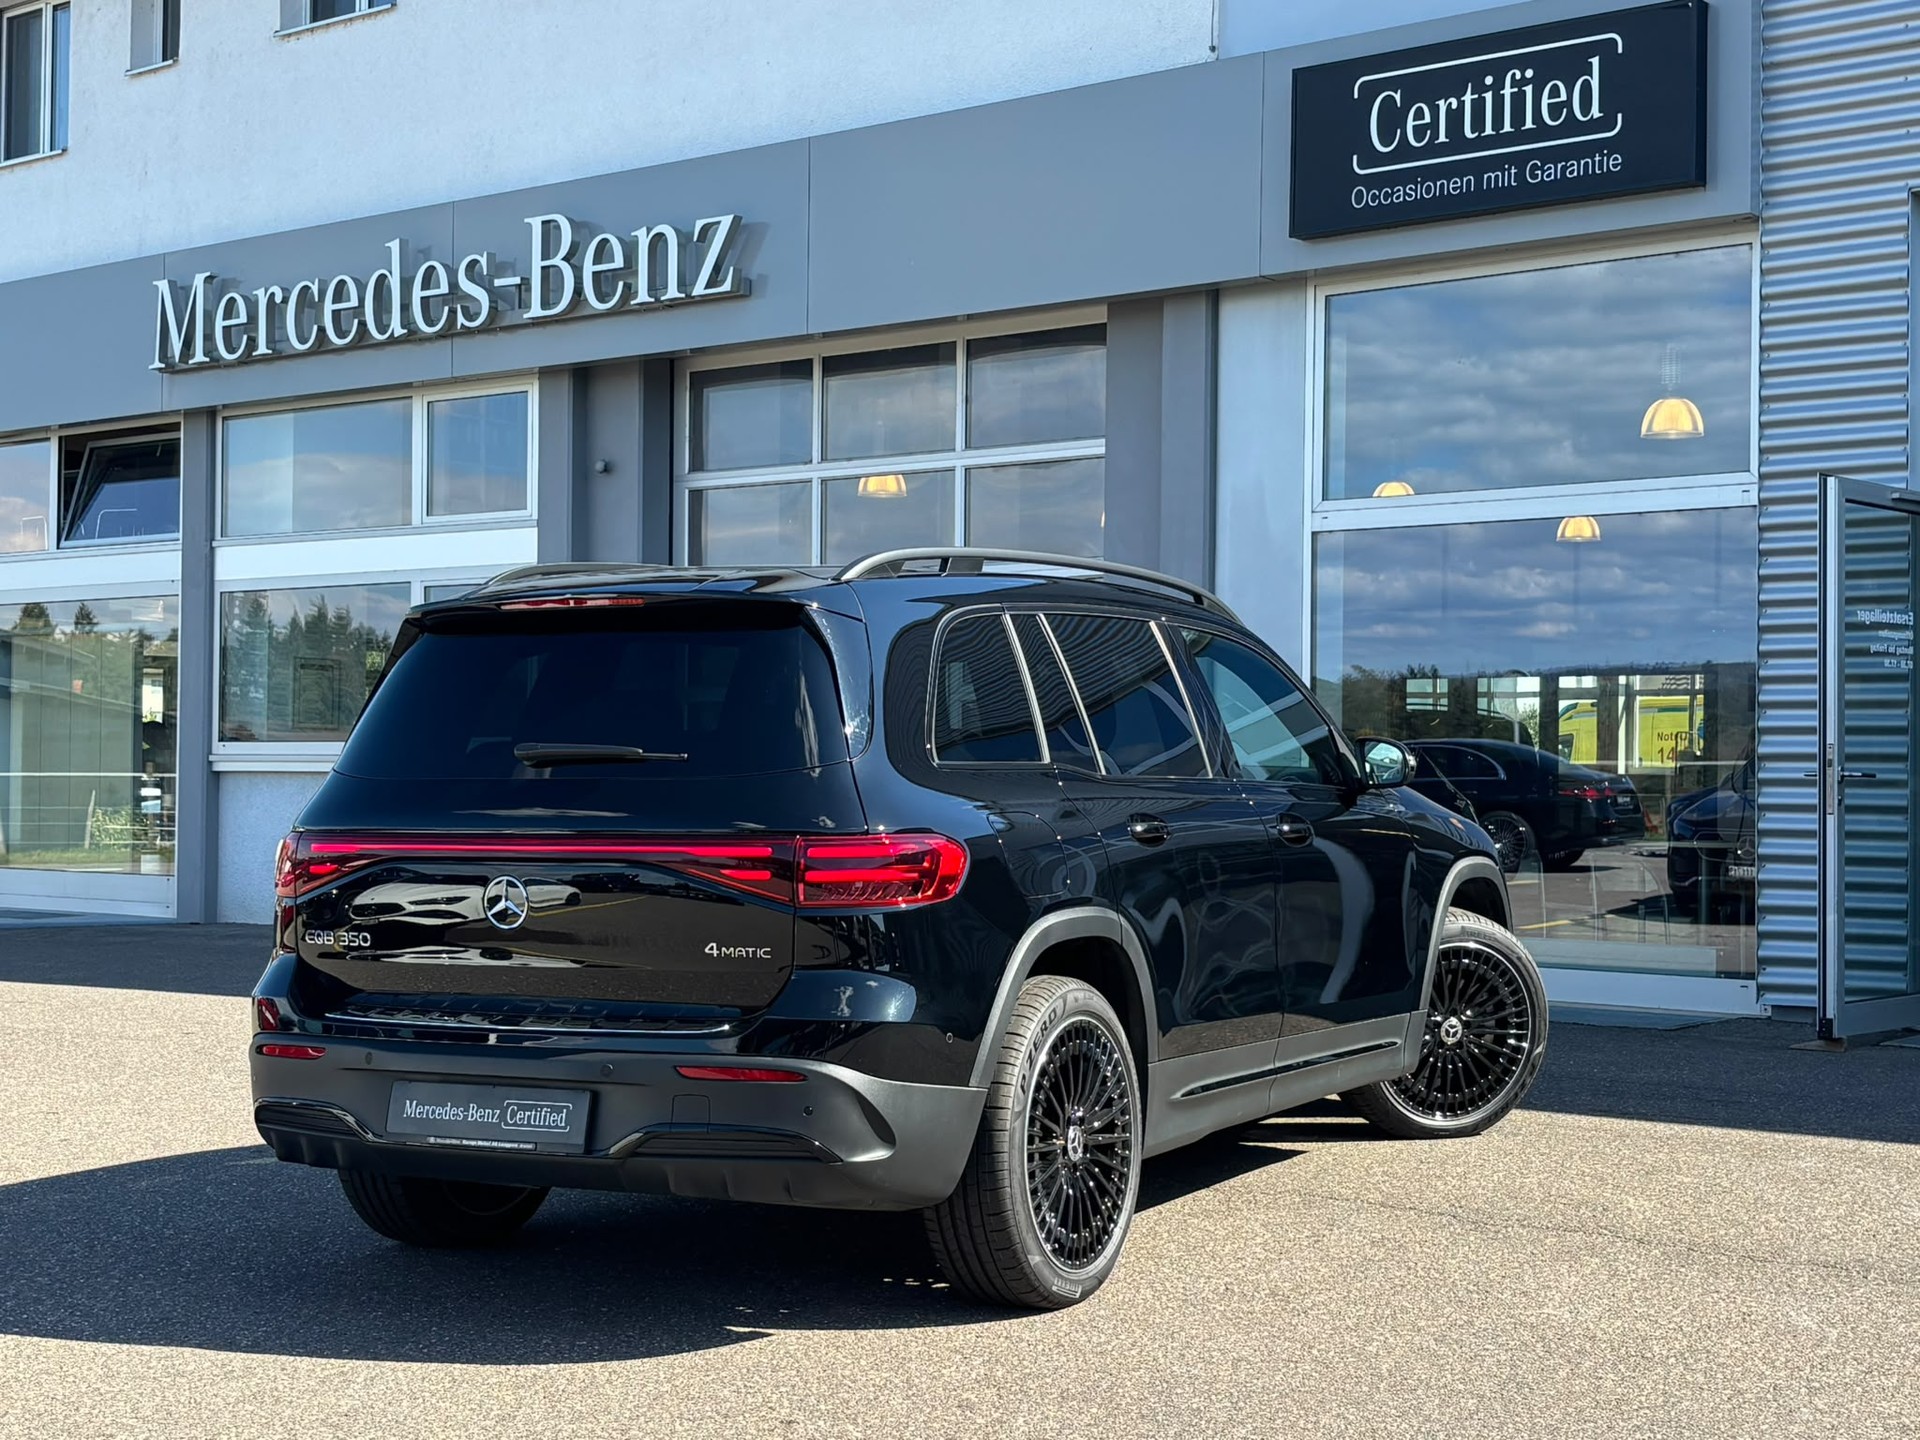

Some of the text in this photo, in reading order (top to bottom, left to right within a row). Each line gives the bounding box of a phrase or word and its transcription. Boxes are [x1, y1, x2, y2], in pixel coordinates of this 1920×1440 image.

[1369, 55, 1604, 153] Certified
[1351, 149, 1622, 209] Occasionen mit Garantie
[148, 212, 746, 371] Mercedes-Benz
[305, 929, 371, 947] EQB 350
[704, 942, 772, 959] 4MATIC
[1026, 1006, 1058, 1072] ZERO
[403, 1099, 567, 1127] Mercedes-Benz Certified
